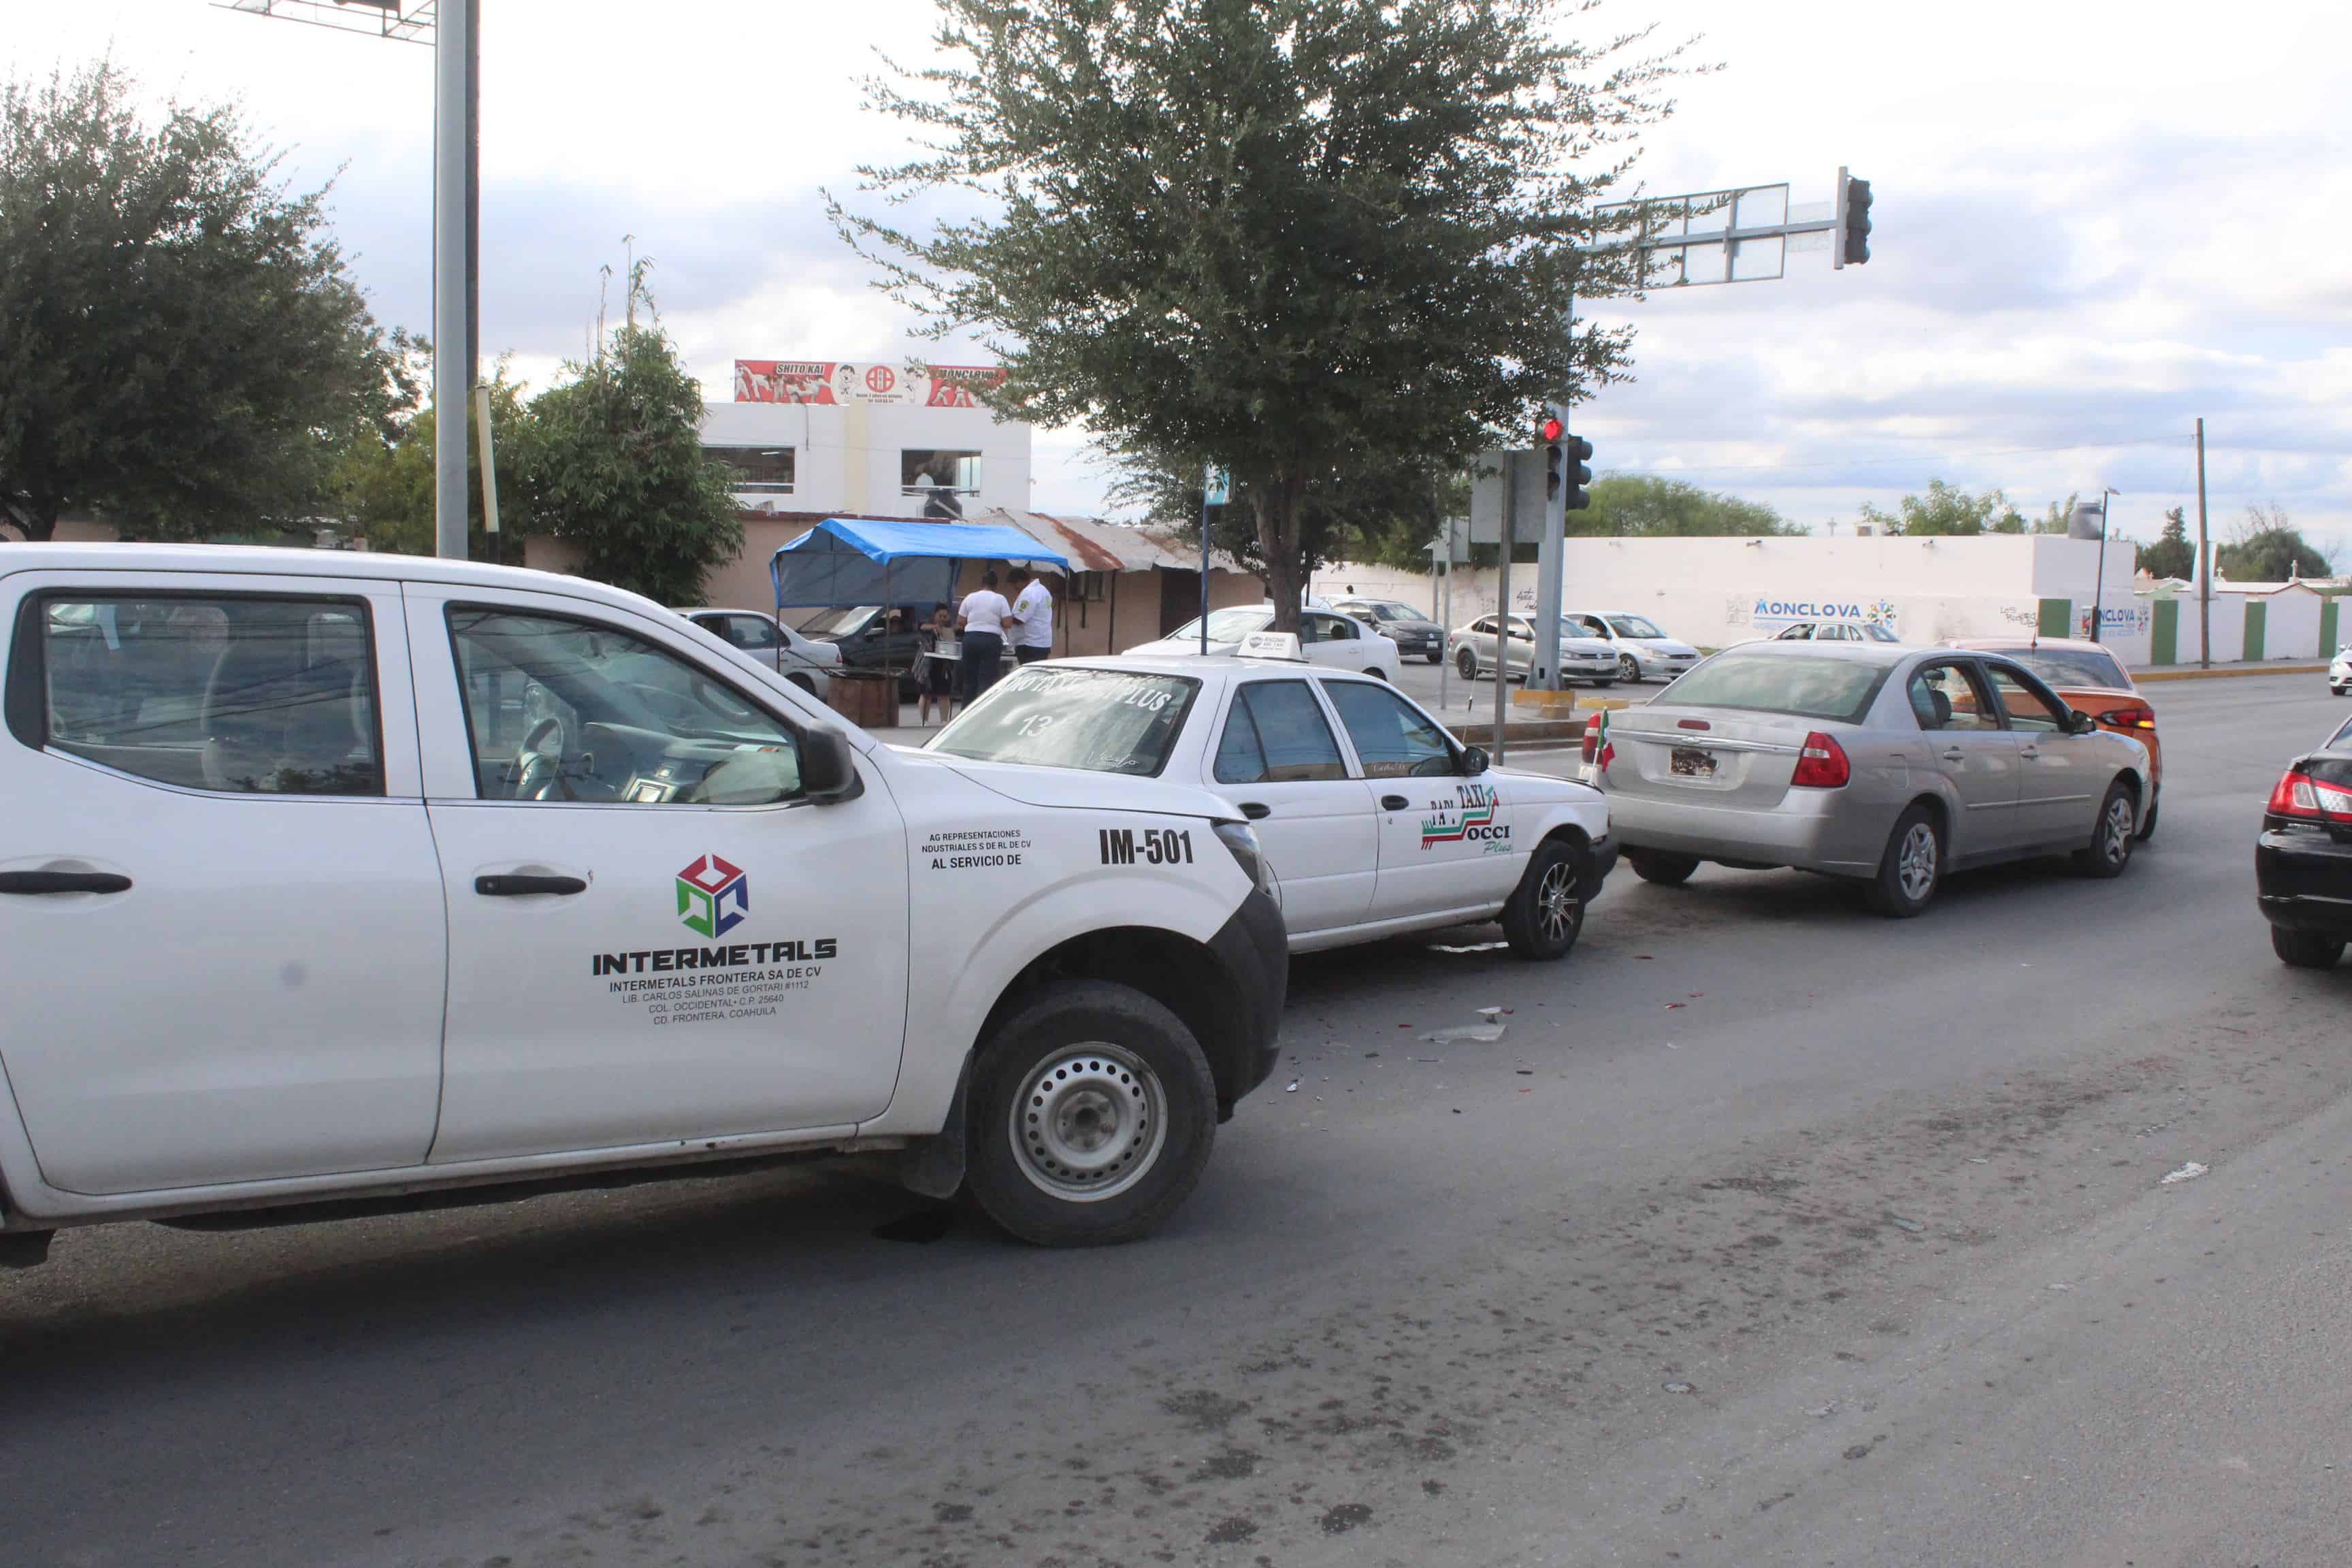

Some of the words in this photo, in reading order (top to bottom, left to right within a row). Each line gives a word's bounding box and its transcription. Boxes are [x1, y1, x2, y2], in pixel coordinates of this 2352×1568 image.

[777, 363, 806, 374] SHITO
[807, 364, 824, 375] KAI
[1754, 599, 1861, 617] MONCLOVA
[1017, 715, 1054, 736] 13
[1456, 783, 1486, 808] TAXI
[929, 833, 941, 842] AG
[943, 829, 1021, 841] REPRESENTACIONES
[1467, 825, 1510, 840] OCCI
[986, 842, 996, 850] DE
[998, 841, 1008, 849] RL
[1009, 840, 1019, 849] DE
[1021, 840, 1032, 848] CV
[1099, 828, 1194, 865] IM-501
[931, 858, 947, 870] AL
[950, 855, 1004, 868] SERVICIO
[1007, 853, 1022, 865] DE
[593, 938, 837, 976] INTERMETALS
[609, 976, 696, 993] INTERMETALS
[700, 971, 765, 985] FRONTERA
[768, 969, 783, 980] SA
[787, 967, 802, 979] DE
[806, 966, 821, 977] CV
[642, 991, 682, 1002] CARLOS
[685, 987, 725, 998] SALINAS
[727, 986, 740, 996] DE
[742, 983, 783, 994] GORTARI
[758, 994, 784, 1004] 25640
[730, 1007, 777, 1019] COAHUILA
